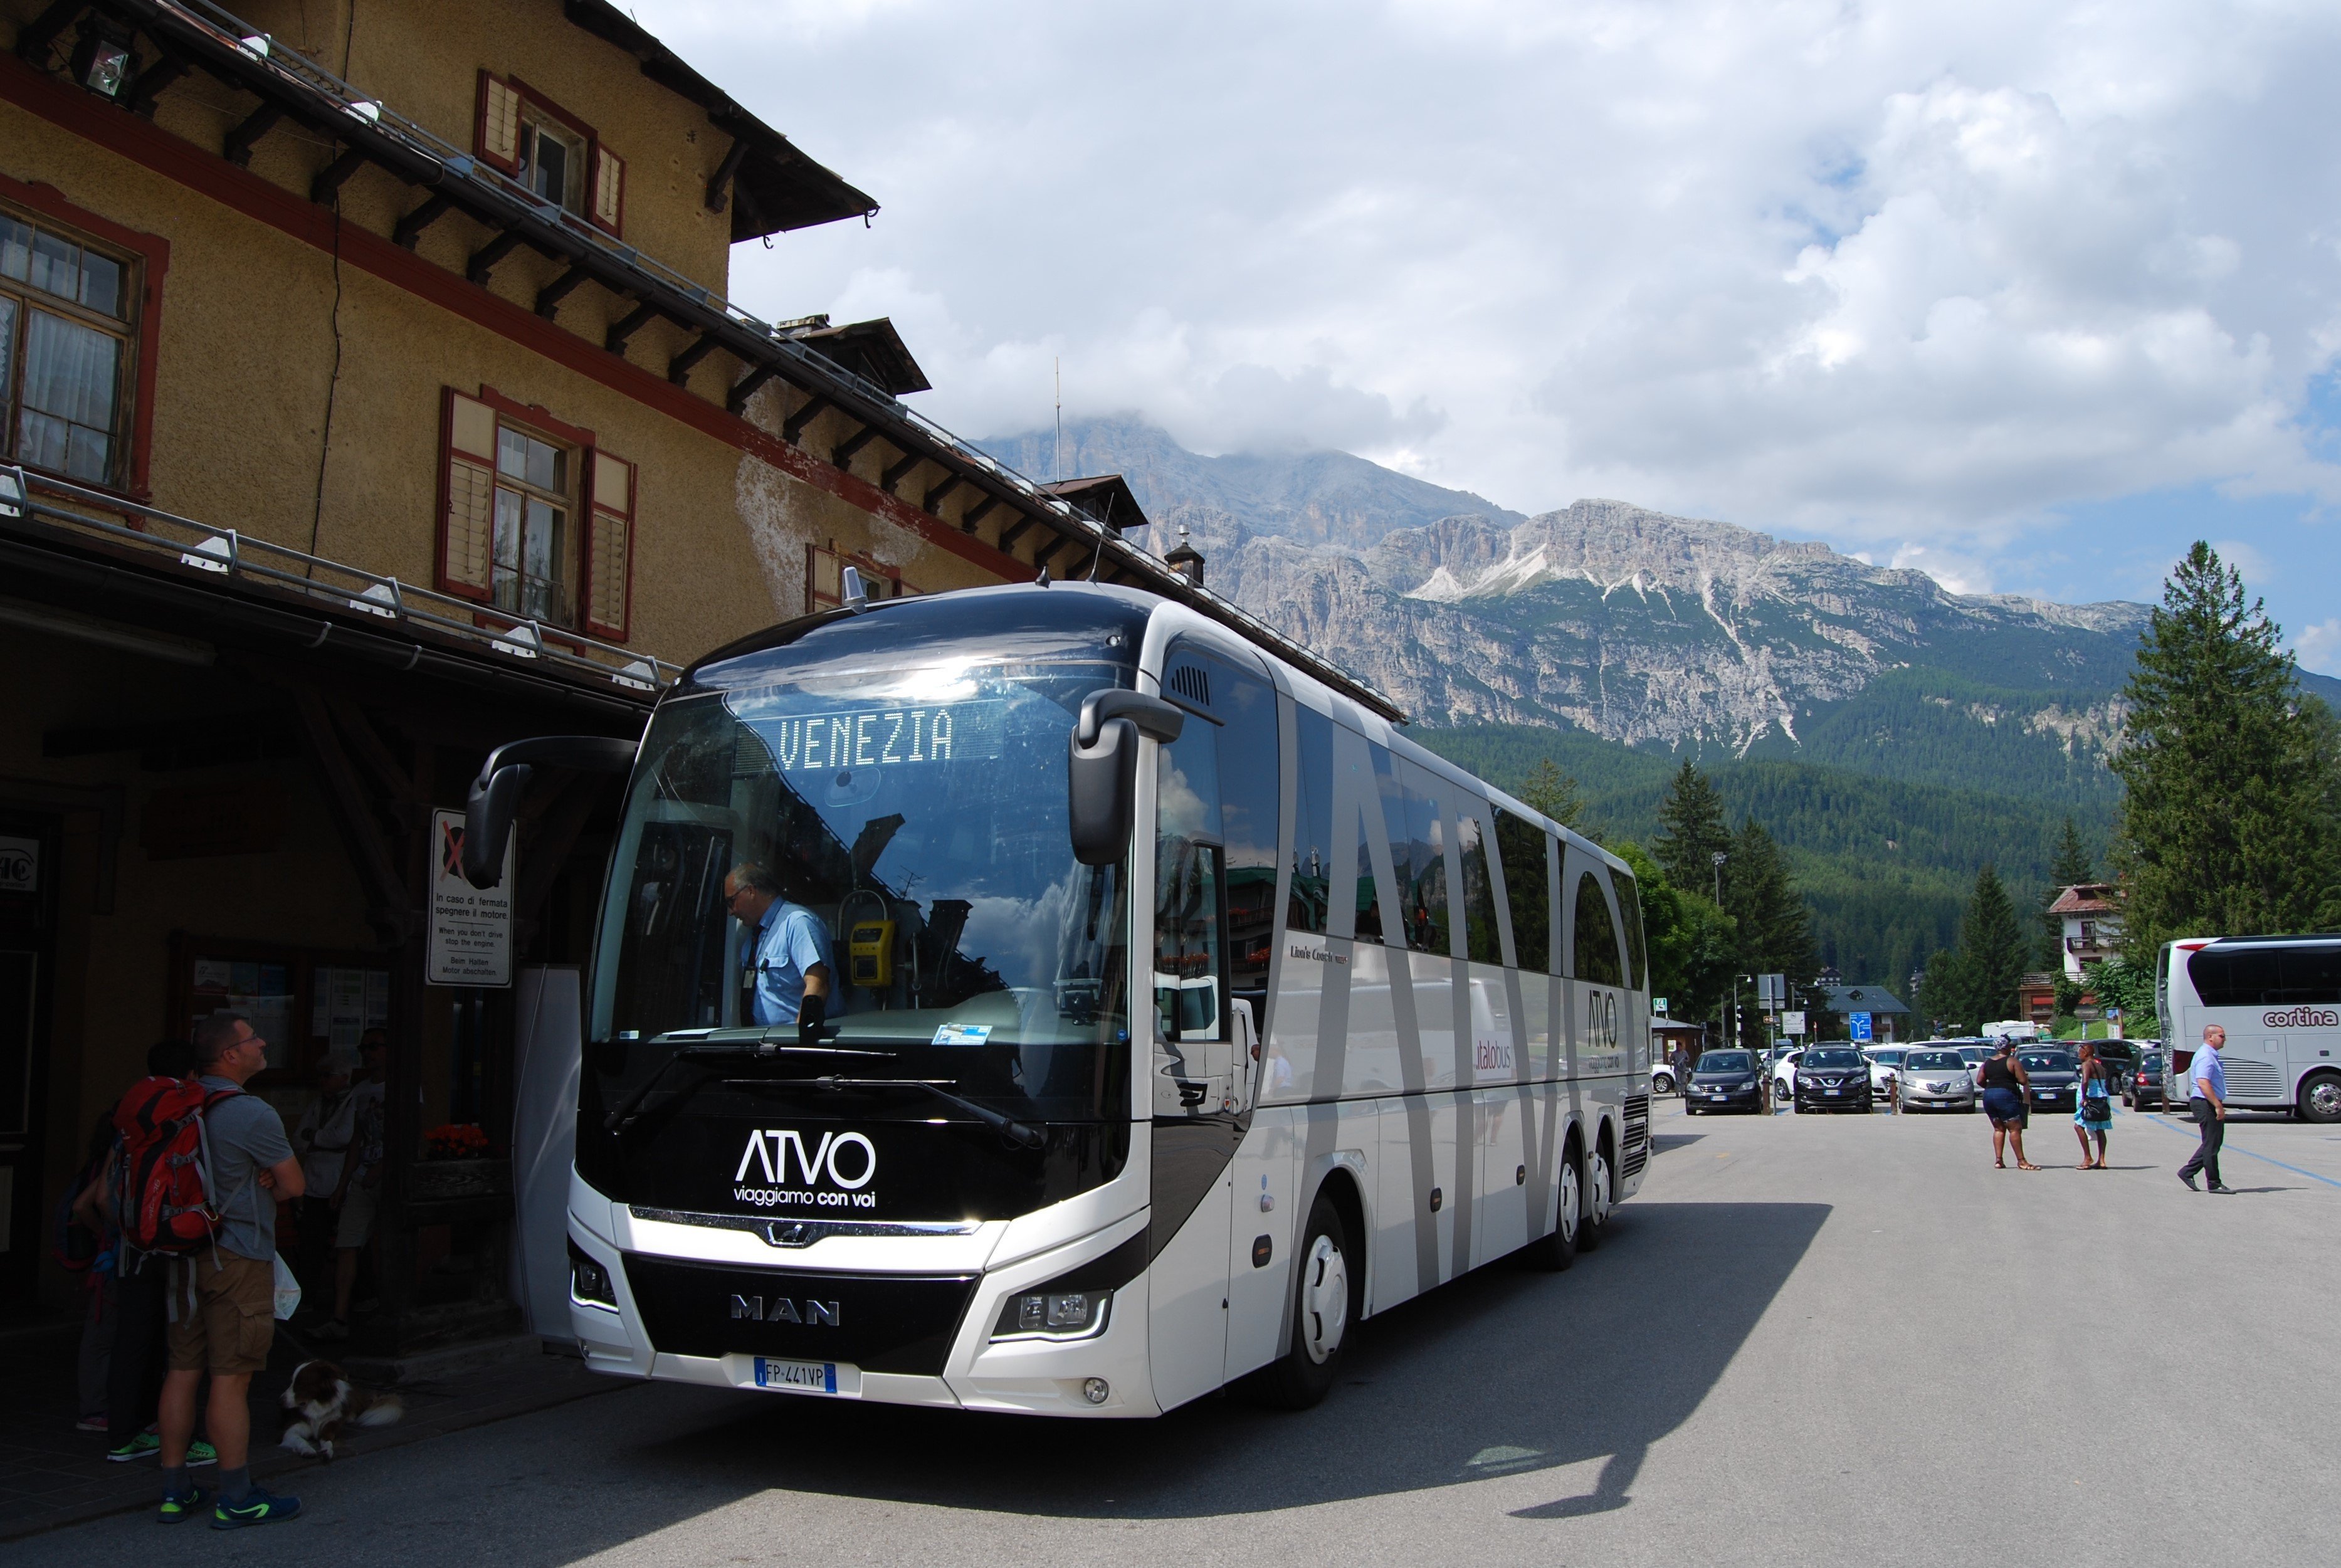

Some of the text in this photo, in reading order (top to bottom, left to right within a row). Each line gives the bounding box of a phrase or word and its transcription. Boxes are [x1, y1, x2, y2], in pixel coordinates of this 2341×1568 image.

[781, 709, 952, 770] VENEZIA
[436, 893, 443, 902] In
[468, 897, 475, 905] di
[479, 897, 508, 908] fermata
[436, 907, 508, 920] spegnere il motore.
[445, 938, 458, 946] stop
[474, 940, 495, 948] engine.
[470, 929, 485, 937] don't
[1290, 945, 1310, 959] Lion's
[1312, 949, 1332, 962] Coach
[1588, 989, 1617, 1049] ATVO
[2263, 1006, 2339, 1028] cortina
[1476, 1039, 1511, 1070] italobus
[735, 1129, 876, 1189] ATVO
[734, 1184, 876, 1208] viaggiamo con voi
[730, 1294, 839, 1326] MAN
